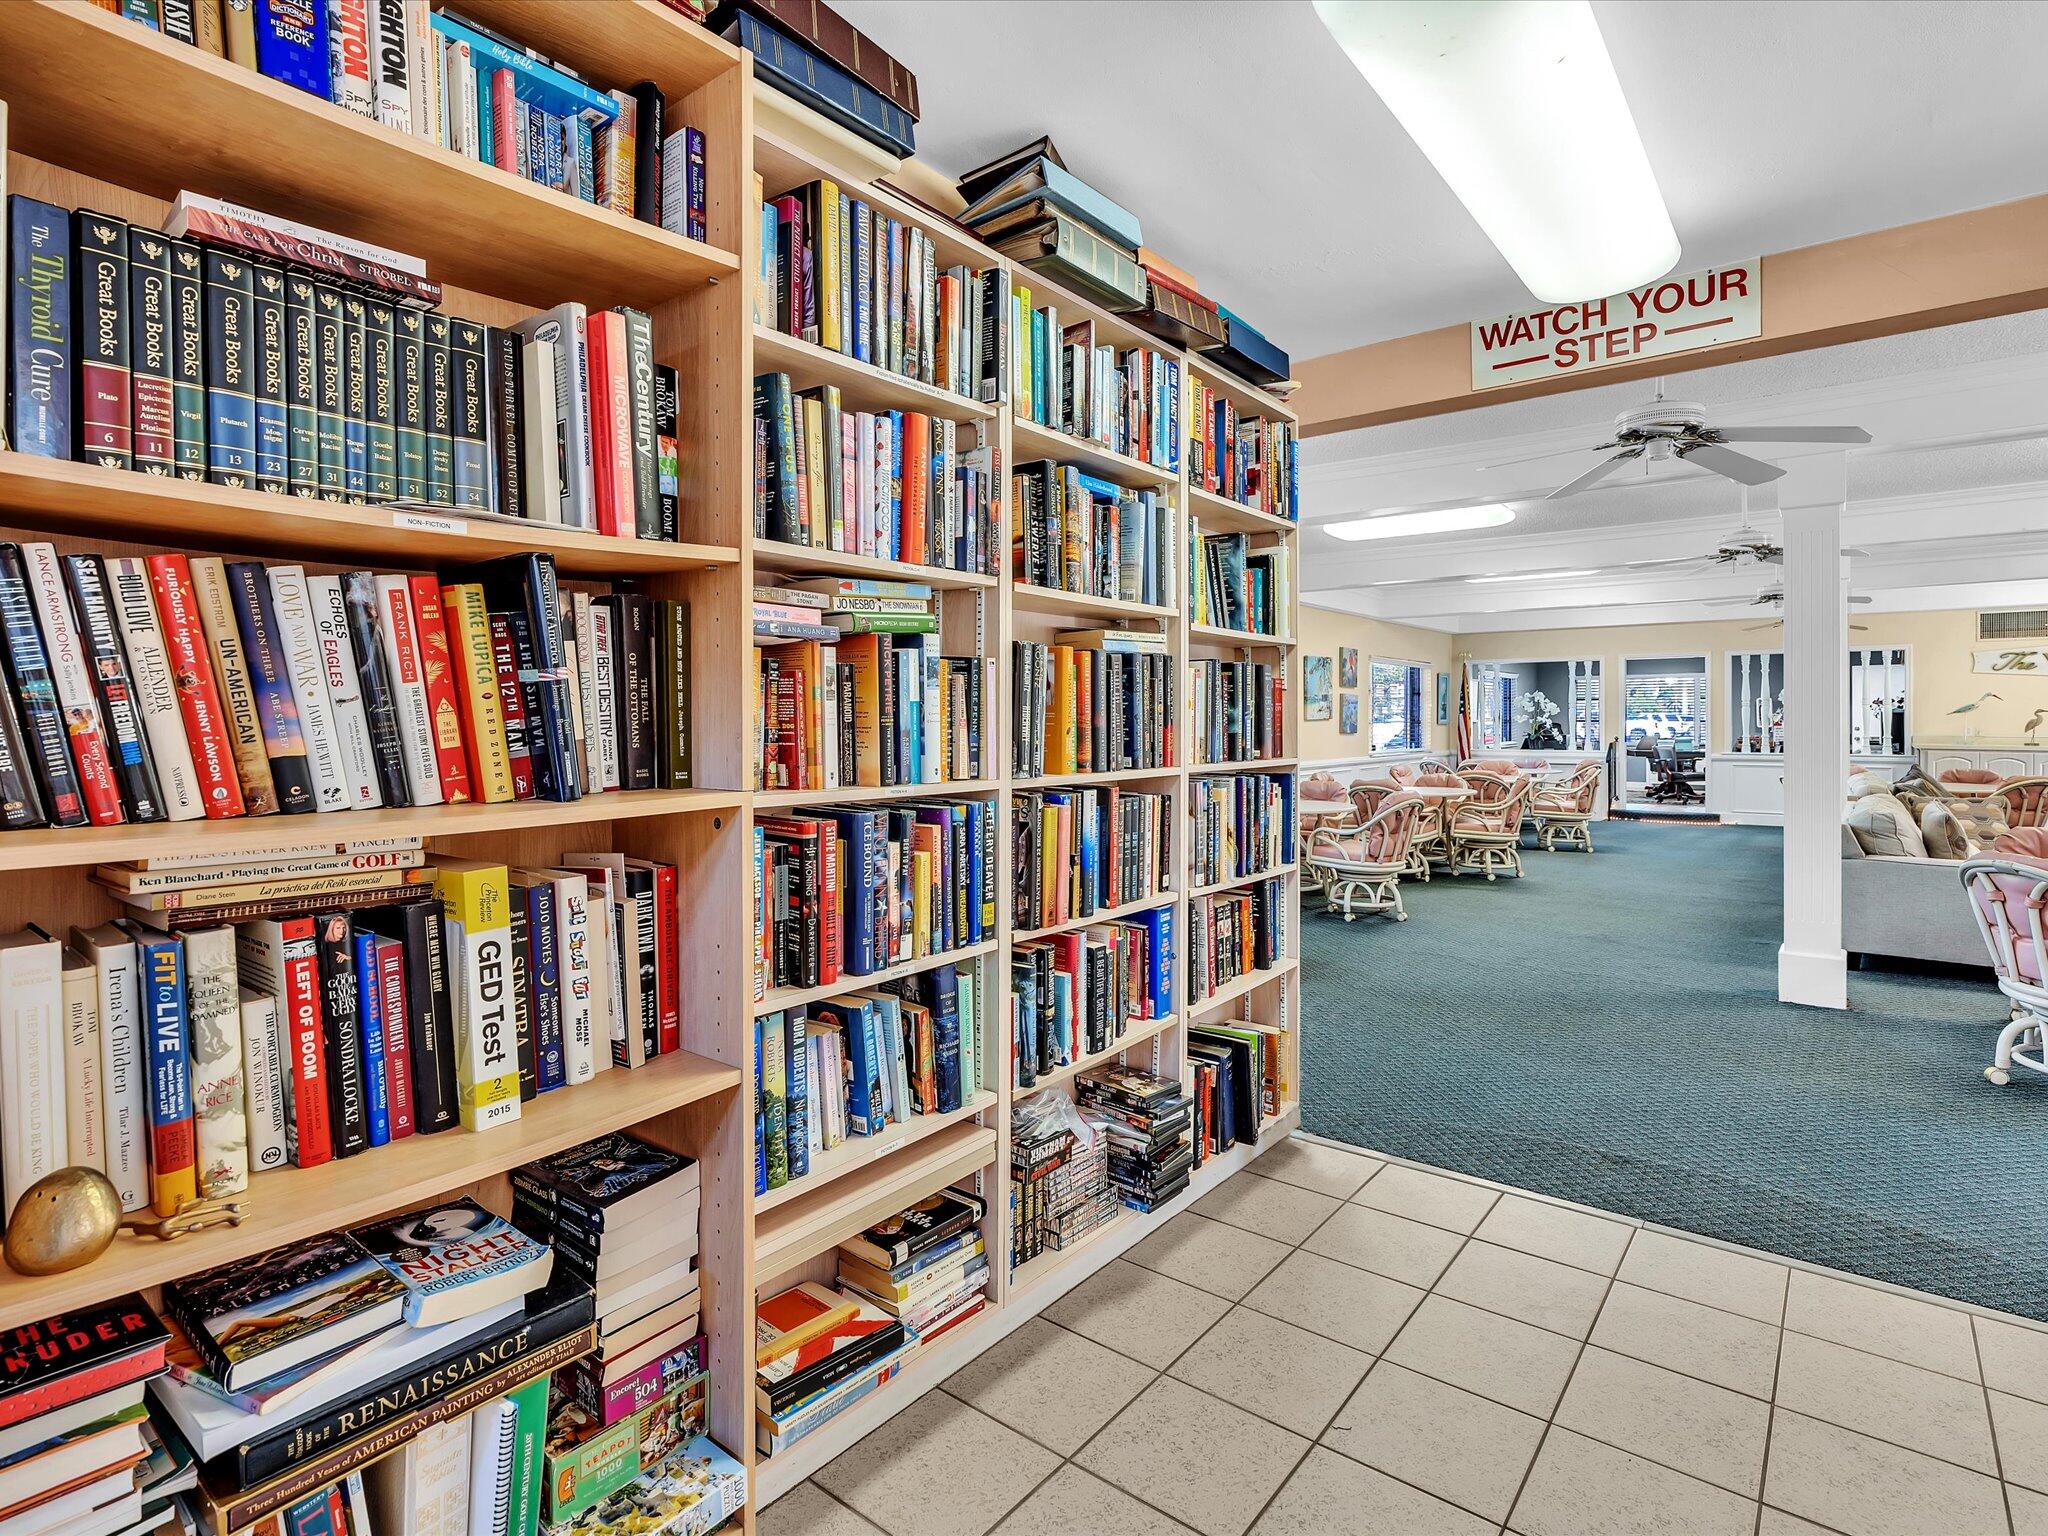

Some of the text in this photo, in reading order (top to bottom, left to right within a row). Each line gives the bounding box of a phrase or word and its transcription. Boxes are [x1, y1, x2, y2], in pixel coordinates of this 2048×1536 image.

[270, 18, 315, 39] REFERENCE
[271, 4, 314, 24] DICTIONARY
[276, 26, 310, 47] BOOK
[492, 46, 533, 70] Holy Bible
[219, 204, 266, 223] TIMOTHY
[858, 202, 870, 242] DAVID
[243, 227, 411, 286] CASE FOR Christ STROBEL
[316, 235, 397, 264] The Reason for God
[792, 222, 801, 282] PERFECT CHILD
[858, 244, 870, 301] BALDACCI
[19, 225, 64, 400] The Thyroid Cure
[98, 261, 116, 356] Great Books
[1479, 268, 1748, 351] WATCH YOUR
[578, 342, 587, 392] PHILADELPHIA
[1554, 323, 1657, 368] STEP
[98, 392, 118, 401] Plato
[504, 340, 515, 426] STUDS TERKEL
[656, 376, 667, 429] BROKAW
[1170, 366, 1178, 422] TOM CLANCY
[105, 433, 113, 443] 6
[181, 409, 201, 420] Virgil
[220, 417, 248, 428] Plutarch
[616, 376, 631, 469] MICROWAVE
[150, 442, 162, 452] 11
[185, 449, 198, 459] 12
[228, 455, 241, 464] 13
[409, 485, 419, 494] 51
[469, 493, 479, 502] 54
[935, 460, 943, 495] FLYNN
[408, 519, 451, 529] NON-FICTION
[663, 498, 673, 533] BOOM!
[35, 548, 73, 662] LANCE ARMSTRONG
[76, 560, 116, 650] SEAN HANNITY
[117, 575, 154, 634] BOLD LOVE
[243, 572, 275, 683] BROTHERS THREE
[328, 589, 347, 639] ECHOES
[837, 597, 919, 610] JO NESBO SNOWMAN
[205, 566, 256, 744] ERIK EDSTROM UN-AMERICAN
[276, 574, 318, 687] LOVE WAR
[321, 621, 343, 688] OF EAGLES
[392, 592, 414, 680] FRANK RICH
[466, 591, 493, 684] MIKE LUPICA
[143, 646, 172, 712] ALLENDER
[165, 568, 222, 782] FURIOUSLY HAPPY JENNY LAWSON
[883, 638, 891, 714] NICK PETRIE
[1993, 651, 2038, 671] The
[501, 681, 523, 752] 12TH MAN
[599, 689, 613, 738] DESTINY
[844, 681, 852, 722] PARANOID
[82, 753, 93, 780] Counts
[89, 740, 110, 789] Every Second
[139, 853, 401, 887] Ken Blanchard GOLF
[825, 826, 836, 893] STEVE MARTINI
[985, 807, 994, 900] JEFFERY DEAVER
[539, 896, 552, 963] JOJO MOYES
[636, 892, 653, 953] DARKTOWN
[808, 919, 816, 968] DARKFEVER
[826, 910, 836, 930] RULE
[826, 946, 836, 968] NINE
[154, 952, 180, 1053] FIT LIVE
[295, 962, 317, 1079] LEFT OF BOOM
[385, 971, 404, 1052] CORRESPONDENTS
[478, 941, 506, 1066] GED Test
[513, 957, 528, 1046] SINATRA
[109, 966, 130, 1095] Irena's Children
[339, 1021, 359, 1126] SONDRA LOCKE
[794, 1016, 806, 1098] NORA ROBERTS
[198, 1076, 239, 1093] ANNE
[205, 1092, 233, 1107] RICE
[488, 1104, 510, 1118] 2015
[401, 1231, 514, 1273] NIGHT
[412, 1242, 529, 1282] STALKER
[423, 1250, 543, 1293] ROBERT BRYNDZA
[507, 1336, 583, 1379] ALEXANDER ELIOT
[337, 1331, 529, 1436] RENAISSANCE
[610, 1379, 640, 1401] Encore!
[635, 1378, 658, 1400] 504
[246, 1498, 274, 1514] Three
[276, 1479, 314, 1500] Hundred
[318, 1466, 342, 1483] Years
[351, 1416, 428, 1462] AMERICAN
[431, 1385, 494, 1424] PAINTING
[584, 1435, 633, 1468] TEAPOT
[597, 1458, 623, 1480] 1000
